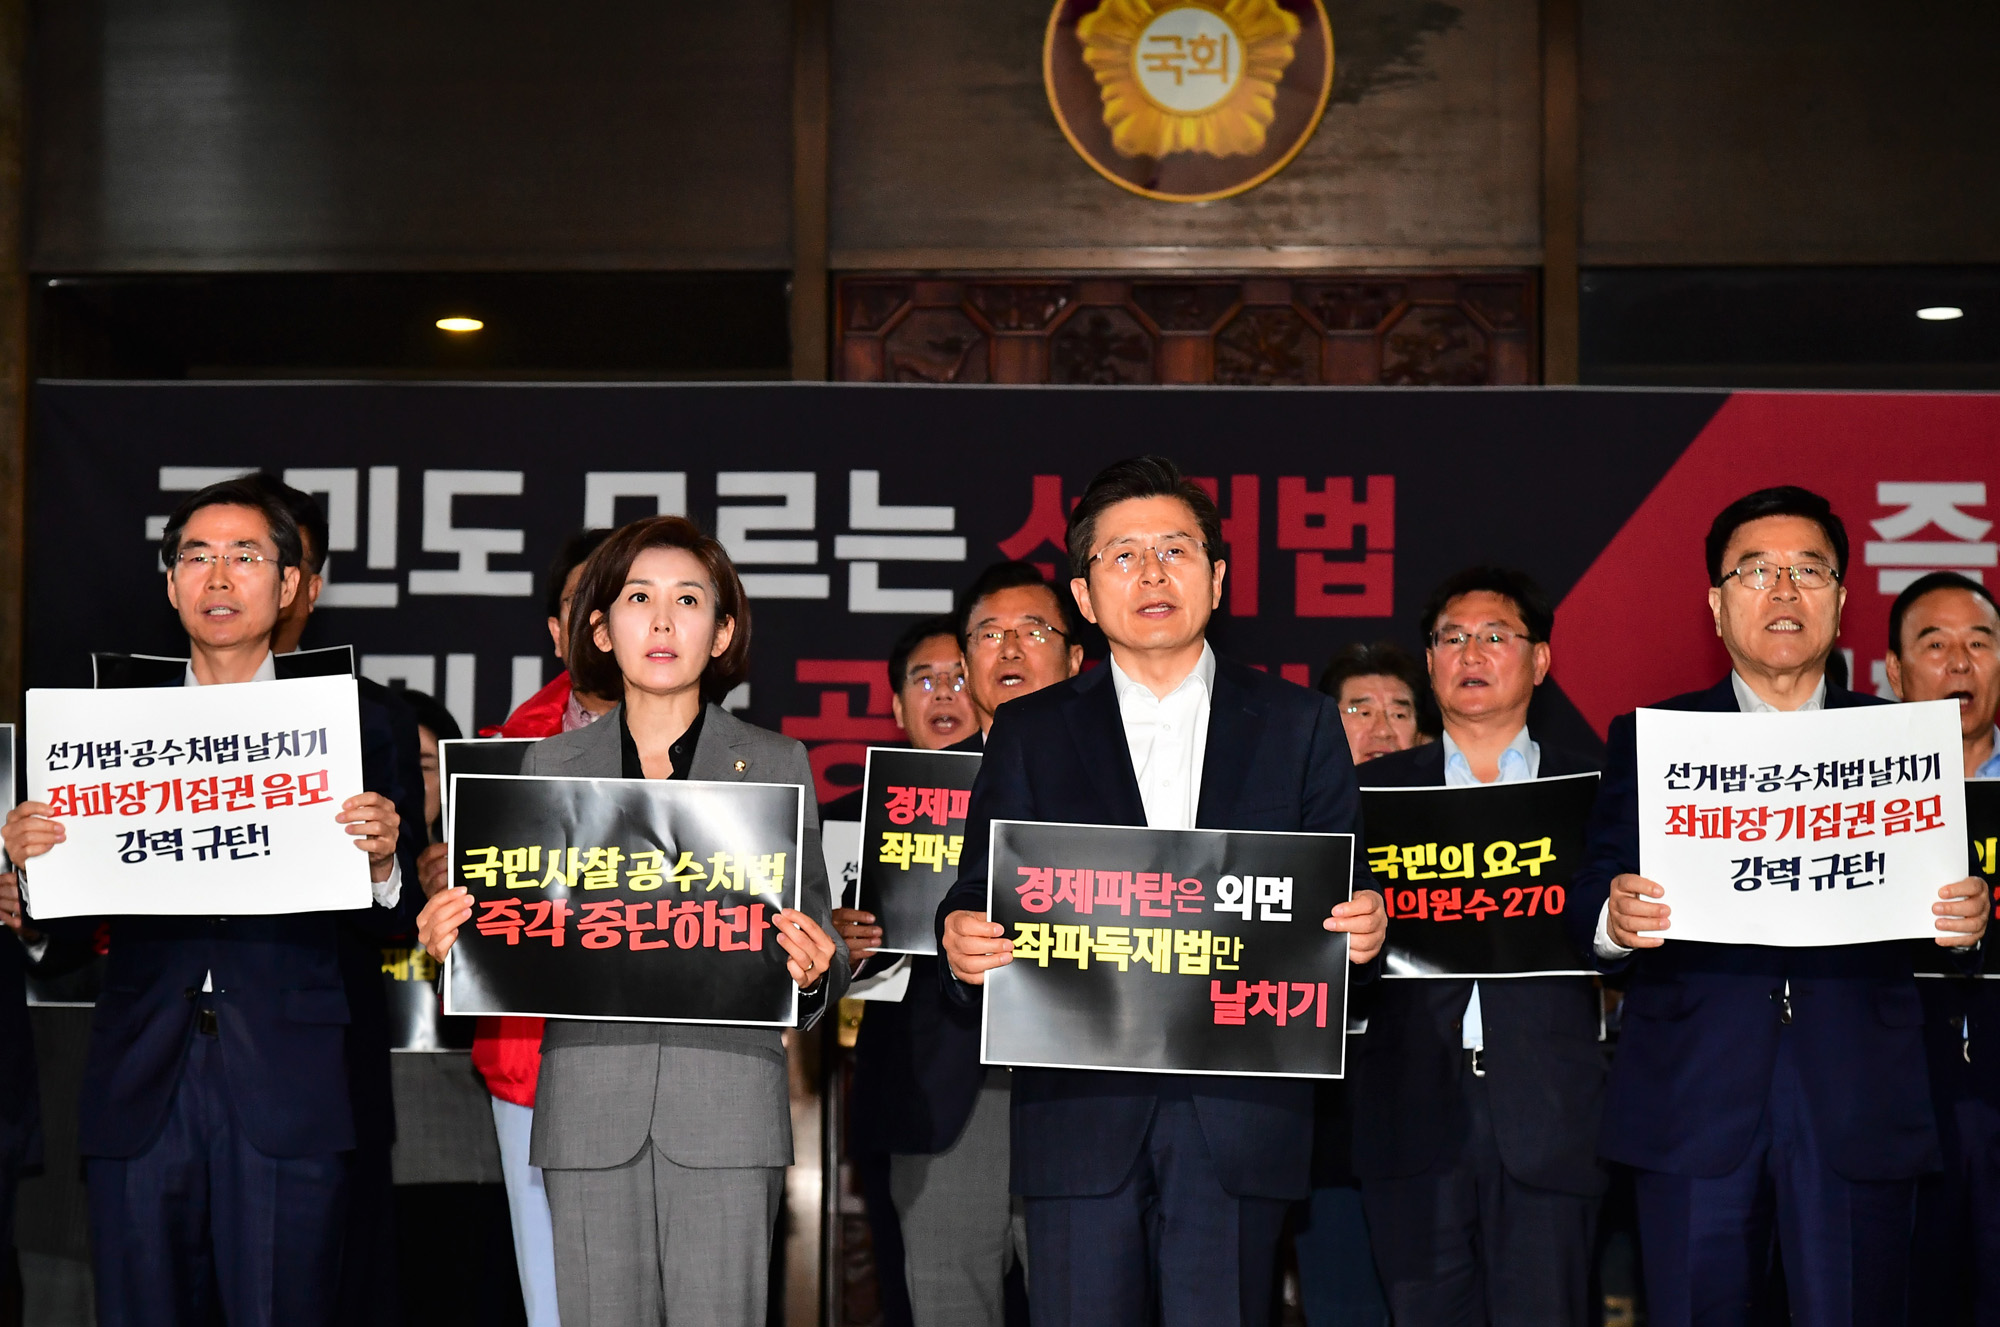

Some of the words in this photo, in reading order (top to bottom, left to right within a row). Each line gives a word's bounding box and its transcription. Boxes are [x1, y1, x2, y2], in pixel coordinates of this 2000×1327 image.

[1142, 33, 1230, 85] 국회
[244, 727, 329, 763] 날치기
[46, 774, 256, 819] 좌파장기집권
[260, 768, 334, 810] 음모
[1869, 752, 1942, 788] 날치기
[1664, 799, 1876, 842] 좌파장기집권
[1881, 794, 1946, 837] 음모
[115, 828, 184, 864] 강력
[191, 822, 271, 862] 규탄!
[1367, 842, 1475, 881] 국민의
[1481, 836, 1557, 879] 요구
[461, 845, 626, 891] 국민사찰
[625, 848, 788, 896] 공수처법
[1015, 866, 1206, 918] 경제파탄은
[1213, 875, 1294, 922] 외면
[1731, 855, 1802, 892] 강력
[1808, 850, 1886, 891] 규탄!
[475, 897, 574, 947] 즉각
[577, 899, 771, 952] 중단하라
[1502, 885, 1566, 918] 270
[1012, 922, 1244, 976] 좌파독재법만
[1210, 980, 1328, 1028] 날치기
